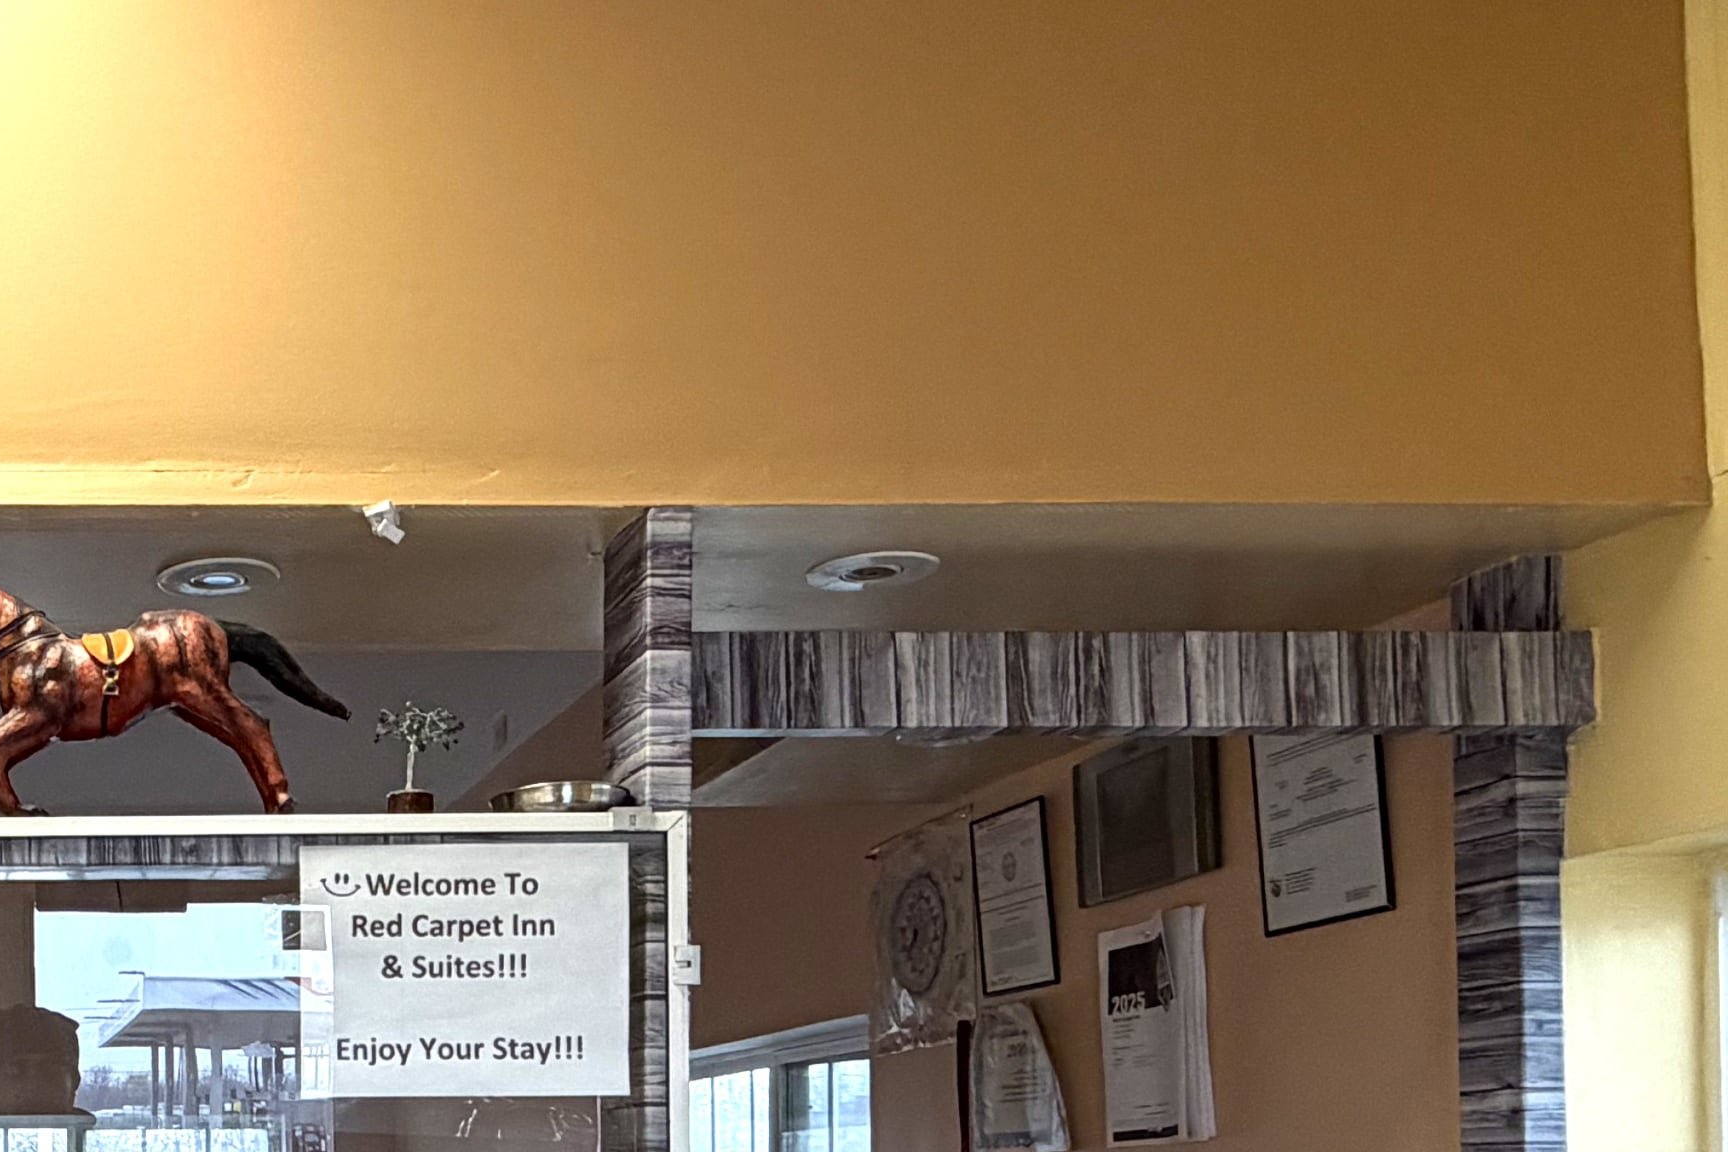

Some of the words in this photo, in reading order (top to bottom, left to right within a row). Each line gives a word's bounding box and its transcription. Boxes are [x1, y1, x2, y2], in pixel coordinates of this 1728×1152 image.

[364, 872, 497, 897] Welcome
[503, 872, 540, 896] To
[351, 913, 403, 938] Red
[411, 913, 504, 943] Carpet
[511, 913, 557, 937] Inn
[380, 953, 404, 979] &
[411, 953, 528, 979] Suites!!!
[1112, 991, 1145, 1015] 2025
[335, 1036, 412, 1067] Enjoy
[419, 1036, 485, 1061] Your
[491, 1035, 584, 1066] Stay!!!
